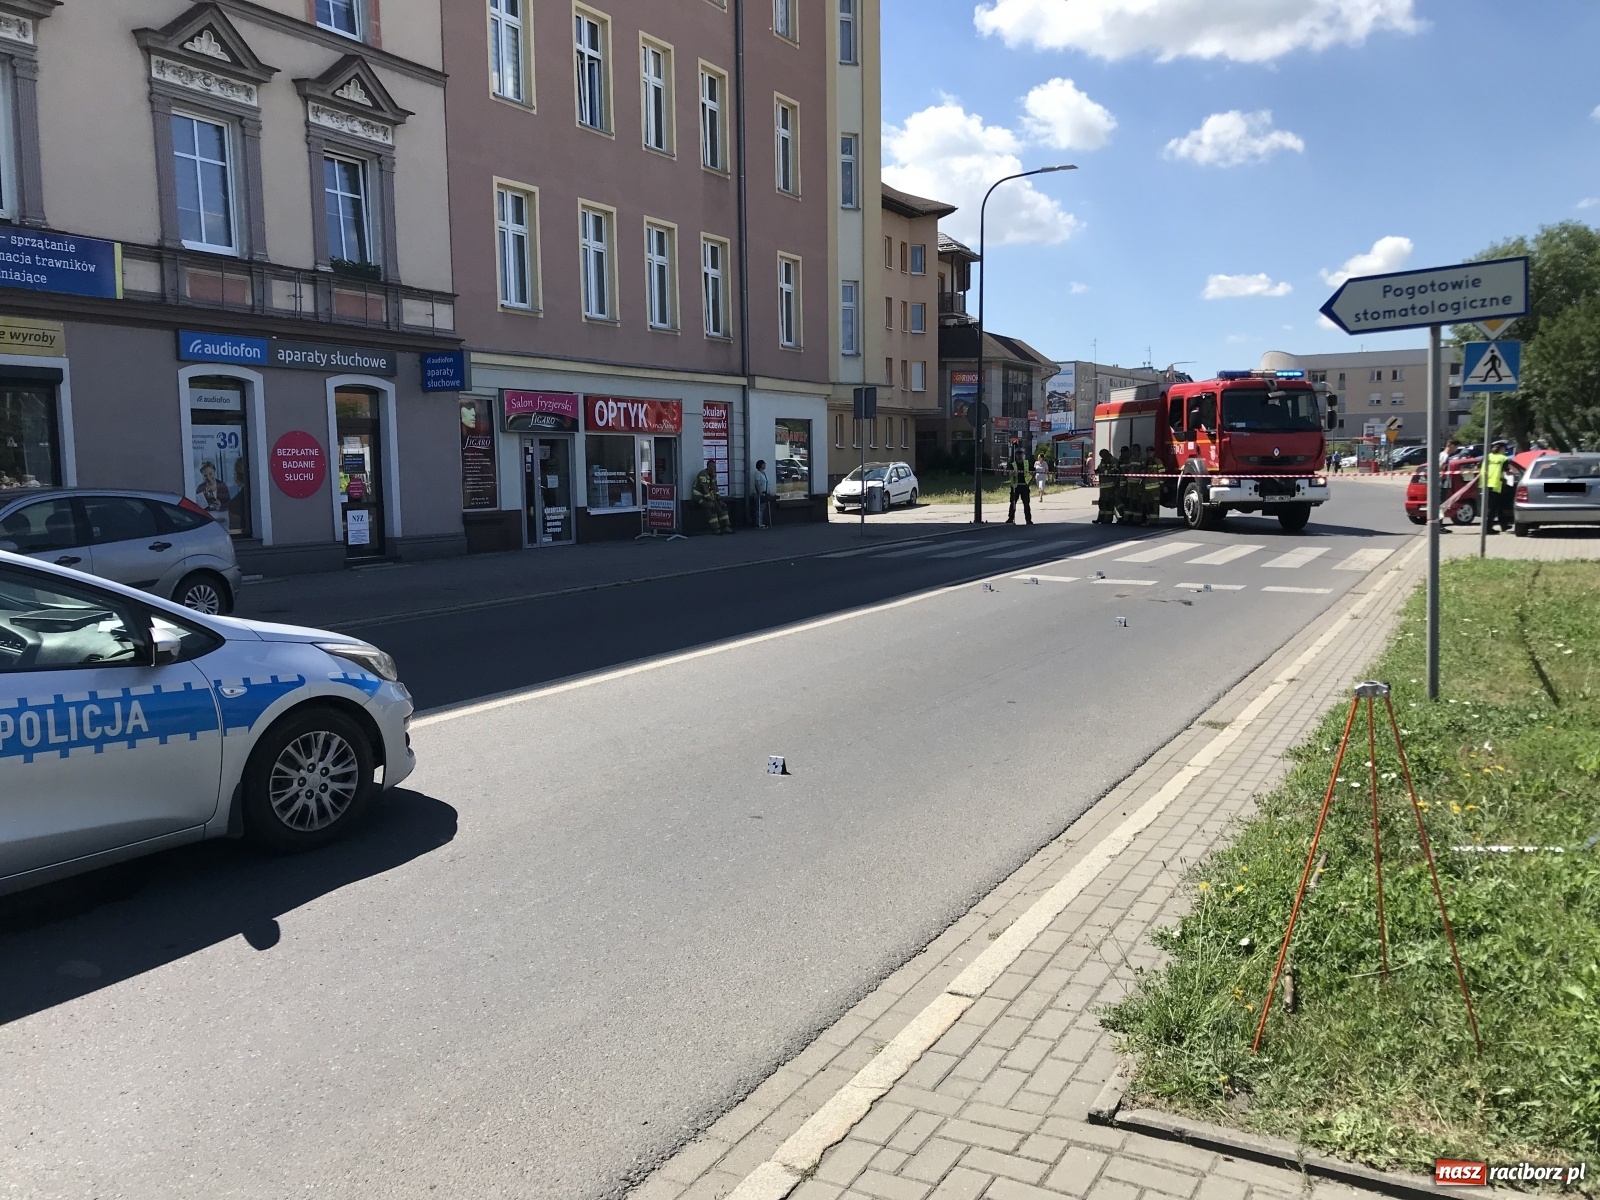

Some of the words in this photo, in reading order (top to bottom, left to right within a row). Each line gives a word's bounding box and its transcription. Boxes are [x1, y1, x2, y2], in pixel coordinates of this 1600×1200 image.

[10, 235, 76, 253] sprzątanie
[35, 254, 96, 273] trawników
[1382, 274, 1482, 299] Pogotowie
[1353, 293, 1513, 323] stomatologiczne
[10, 331, 56, 345] wyroby
[204, 342, 261, 359] audiofon
[277, 348, 328, 367] aparaty
[330, 351, 387, 369] słuchowe
[430, 355, 454, 364] audiofon
[426, 367, 454, 378] aparaty
[427, 377, 461, 388] słuchowe
[203, 396, 231, 404] audiofon
[511, 397, 534, 409] Salon
[535, 397, 573, 412] fryzjerski
[594, 399, 648, 428] OPTYK
[702, 406, 727, 419] okulary
[702, 420, 727, 429] soczewki
[277, 448, 319, 456] BEZPŁATNE
[284, 473, 314, 481] SŁUCHU
[651, 487, 671, 495] OPTYK
[650, 511, 672, 519] okulary
[0, 700, 149, 748] POLICJA
